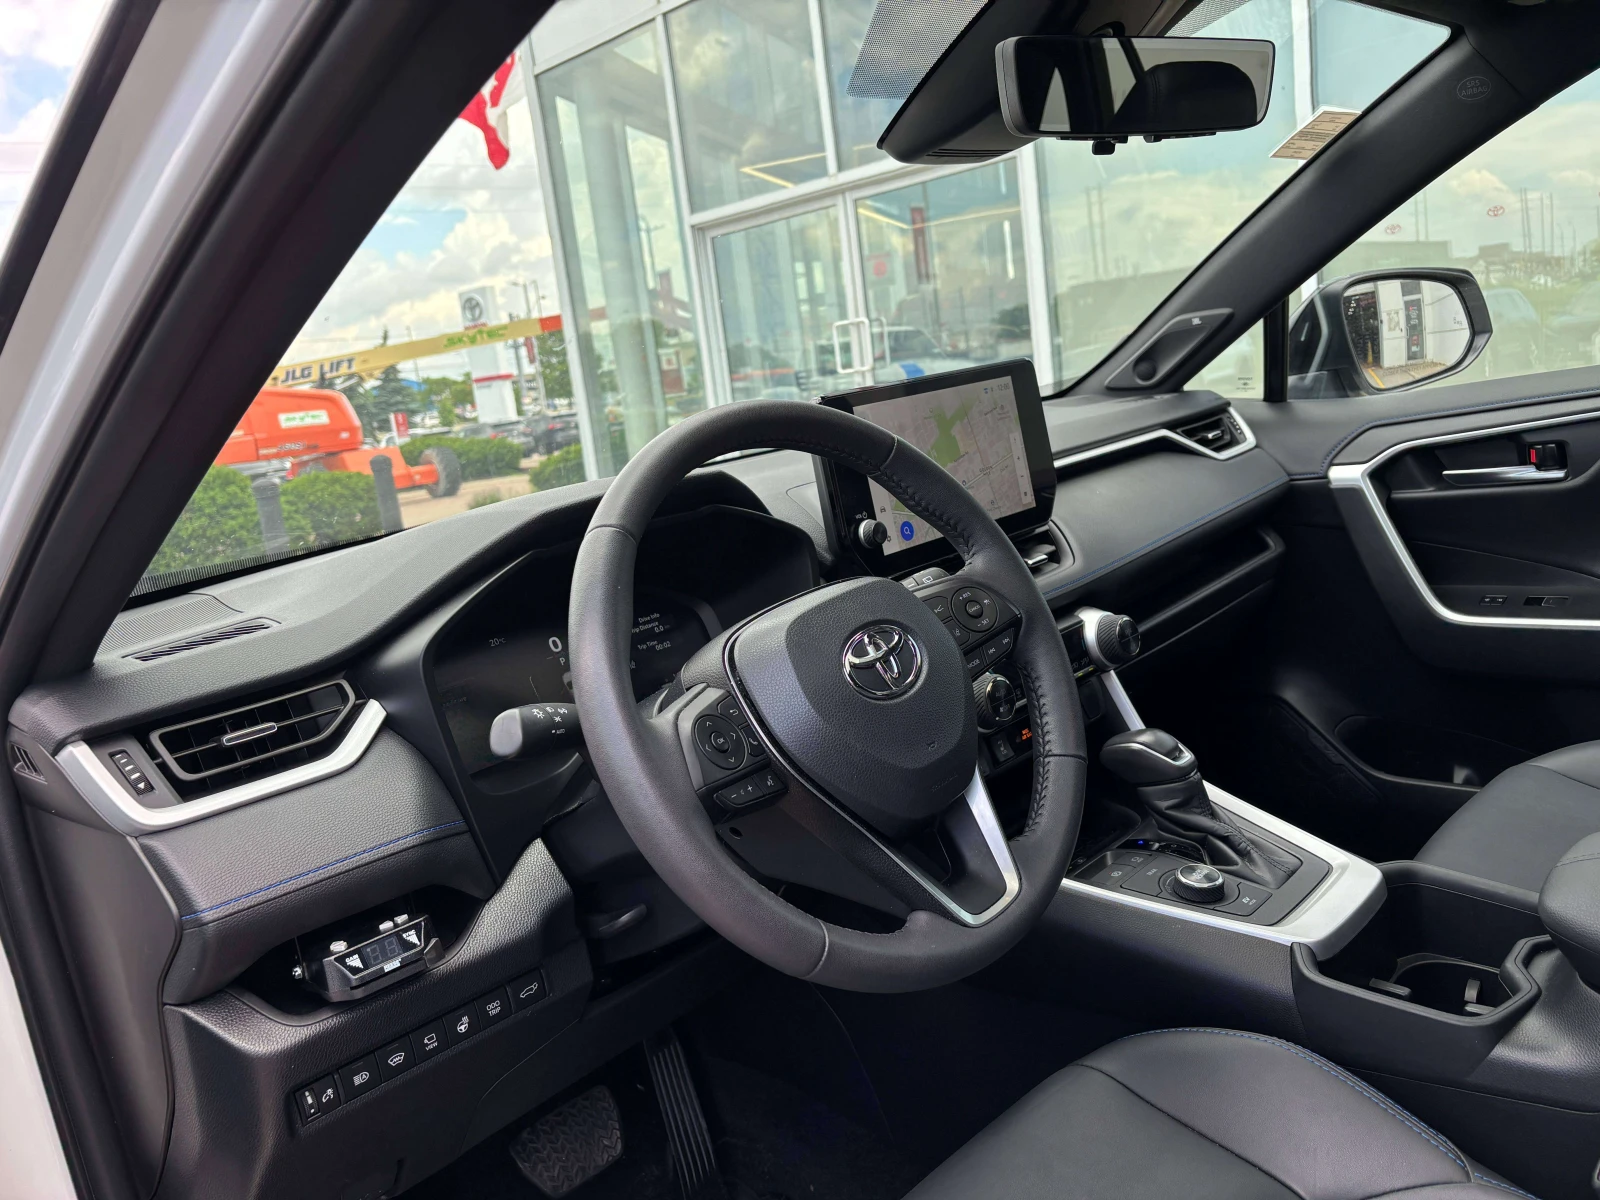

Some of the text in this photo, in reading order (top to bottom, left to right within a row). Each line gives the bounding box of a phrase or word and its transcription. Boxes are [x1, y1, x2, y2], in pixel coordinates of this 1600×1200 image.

[1461, 86, 1488, 96] AIRBAG
[280, 356, 355, 384] JLG LIFT
[548, 636, 562, 652] 0
[559, 657, 566, 666] P
[486, 1000, 501, 1012] ODO
[488, 1006, 502, 1017] TRIP
[425, 1041, 438, 1051] VIEW
